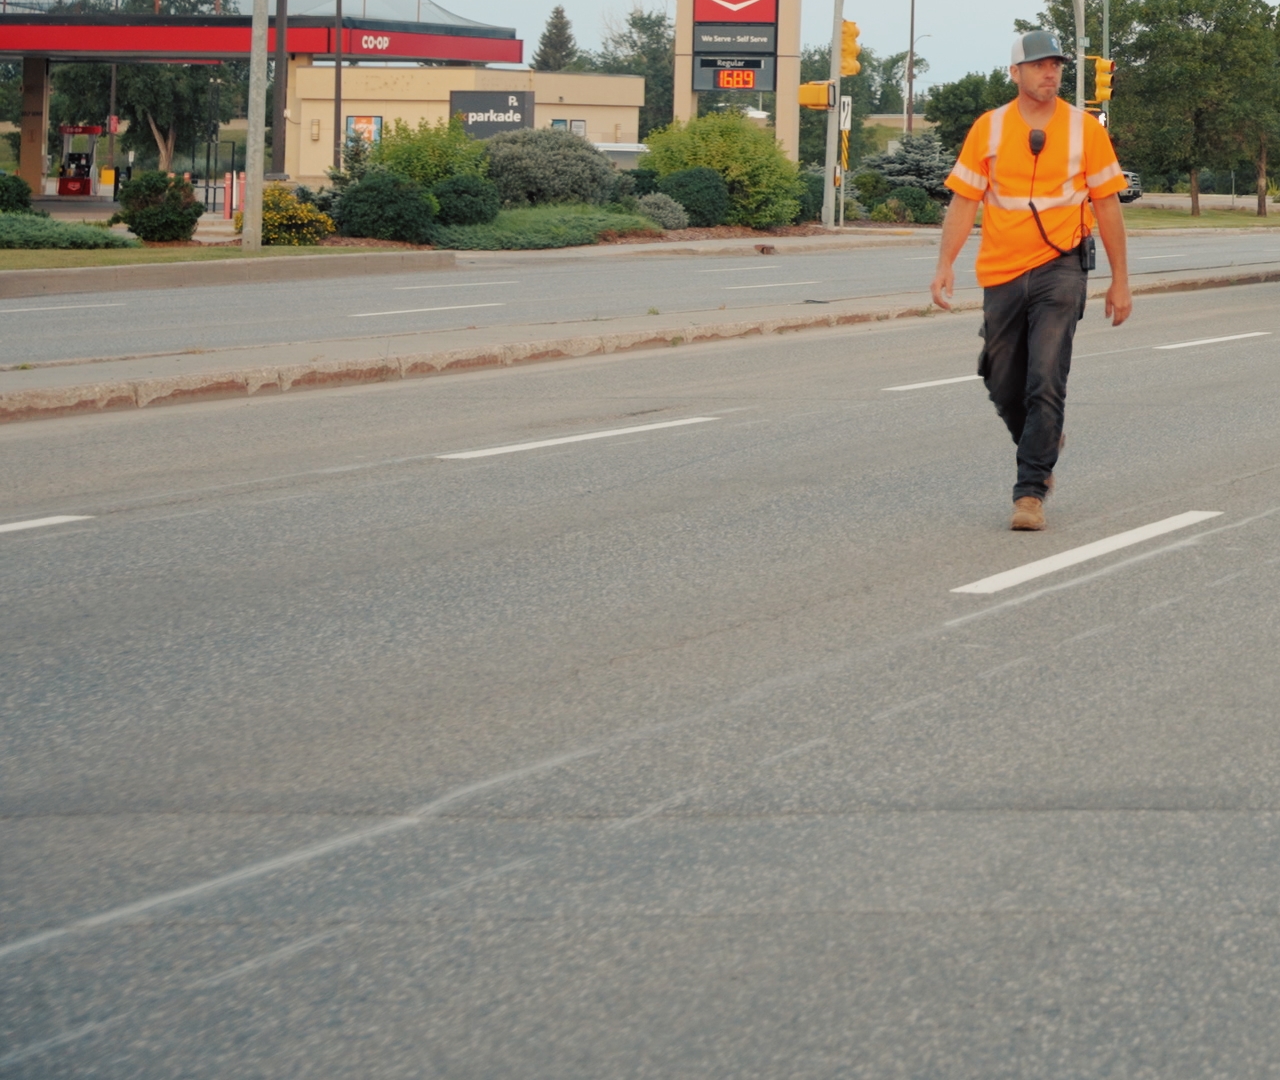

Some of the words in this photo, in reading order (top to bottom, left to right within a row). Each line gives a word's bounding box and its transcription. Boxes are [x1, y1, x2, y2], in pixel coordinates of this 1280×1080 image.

[361, 34, 390, 50] CO-OP
[701, 35, 713, 43] We
[713, 35, 732, 43] Serve
[736, 35, 750, 43] Self
[717, 59, 745, 68] Regular
[468, 109, 522, 125] parkade
